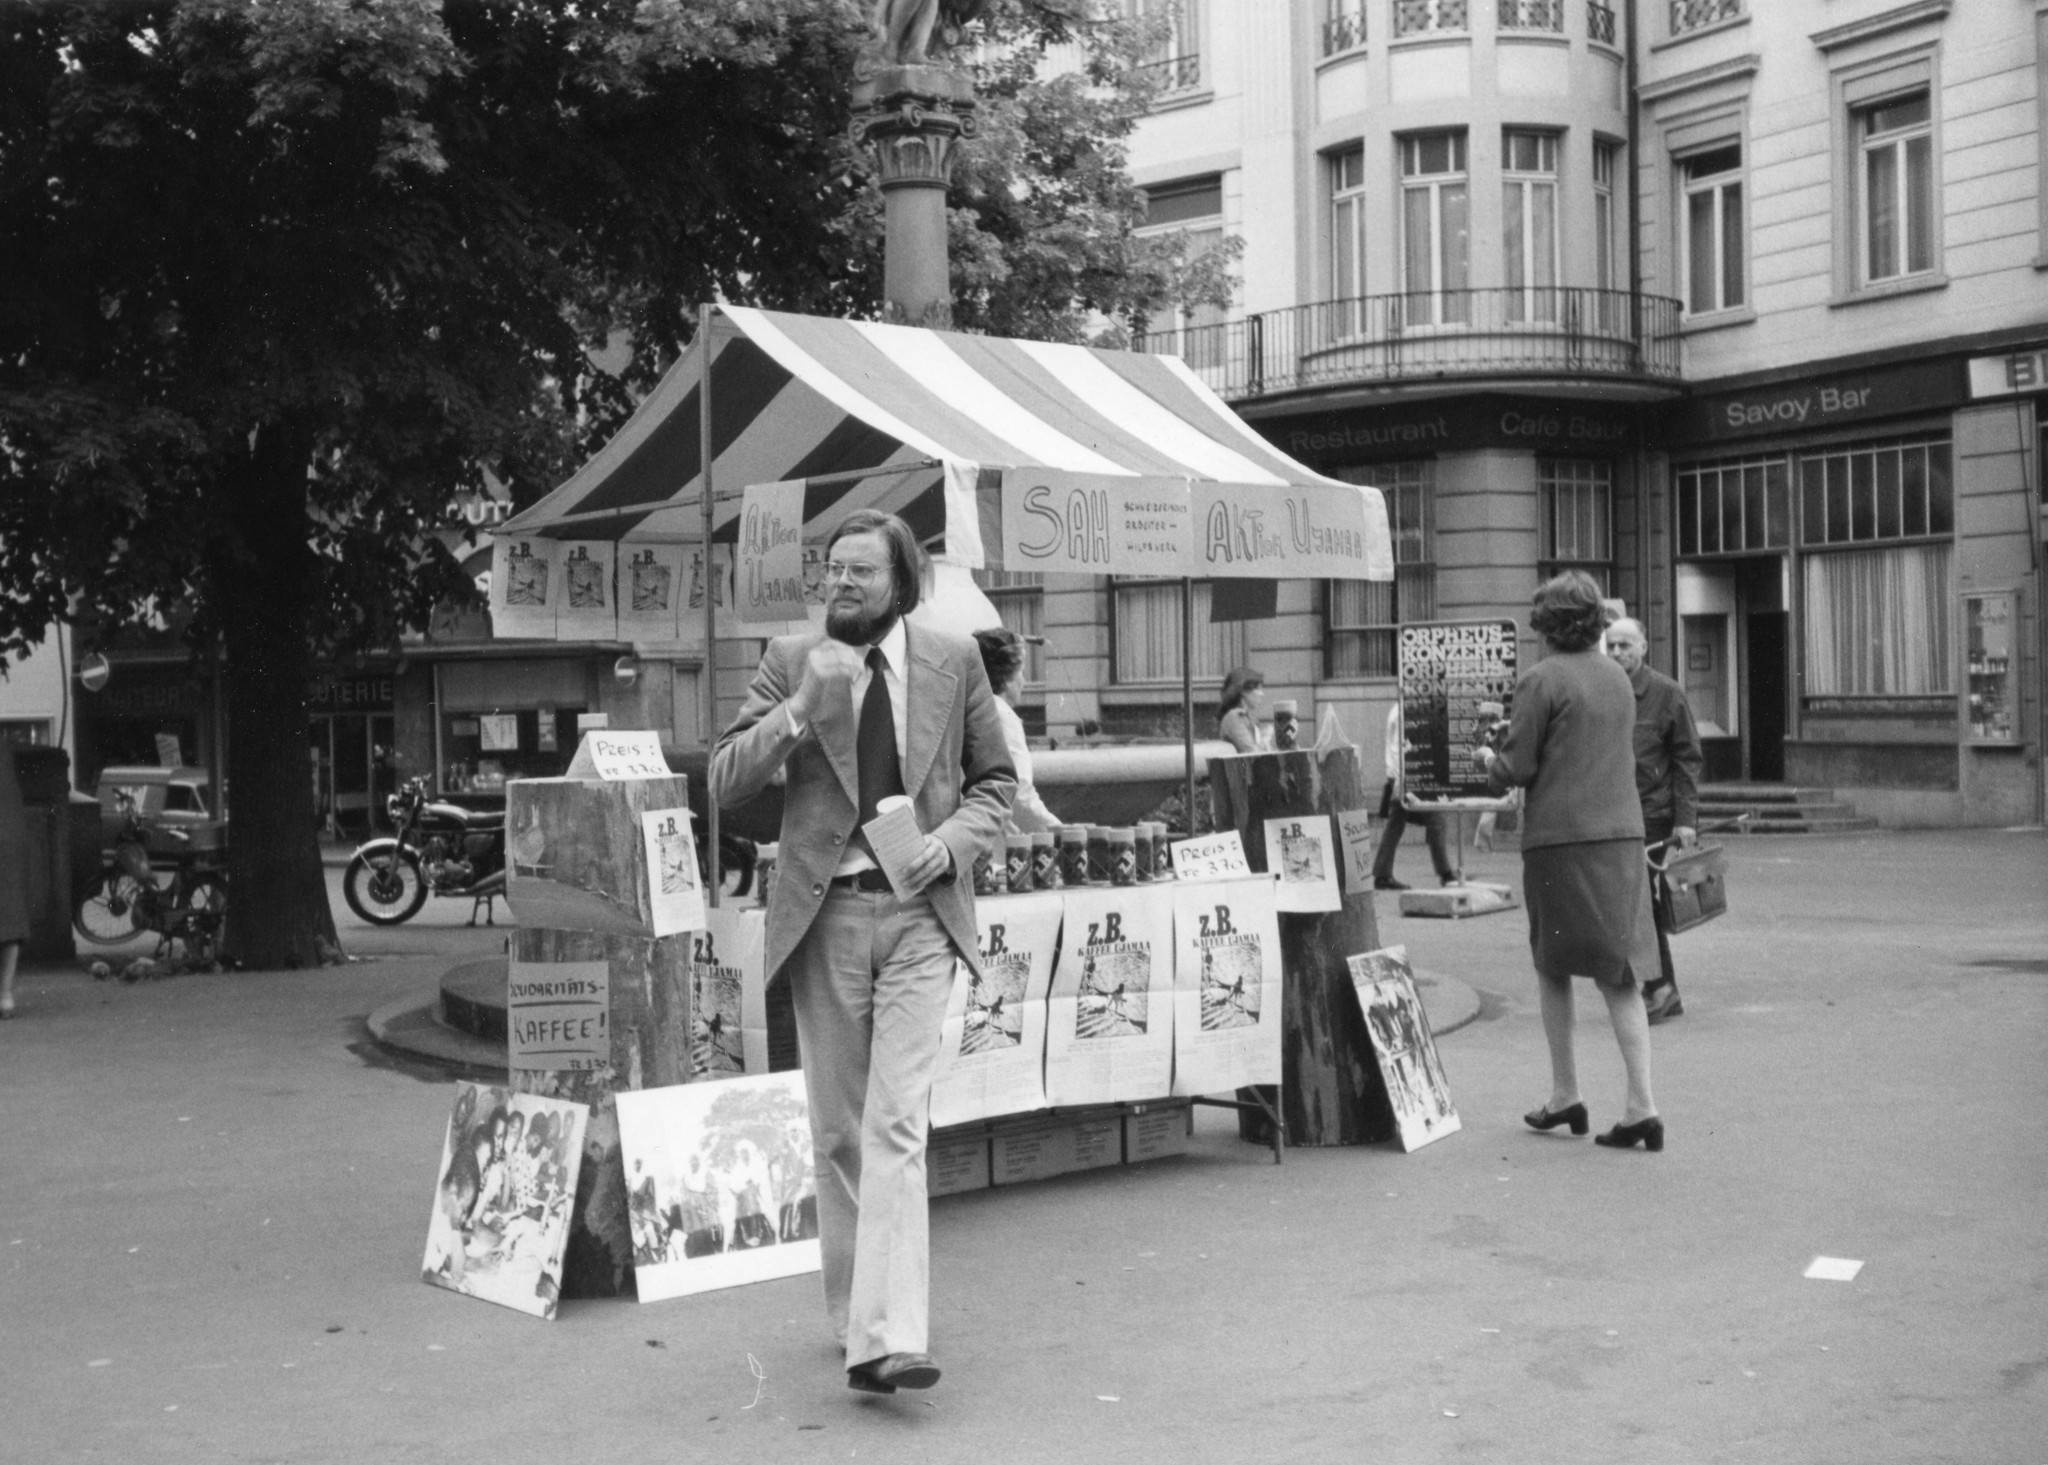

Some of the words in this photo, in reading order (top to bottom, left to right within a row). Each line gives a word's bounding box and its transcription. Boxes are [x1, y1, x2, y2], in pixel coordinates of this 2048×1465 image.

[1727, 397, 1811, 427] Savoy
[1821, 387, 1871, 413] Bar
[1288, 416, 1449, 451] Restaurant
[1568, 415, 1629, 440] Baur
[1018, 485, 1110, 564] SAH
[1403, 642, 1516, 664] KONZERTE
